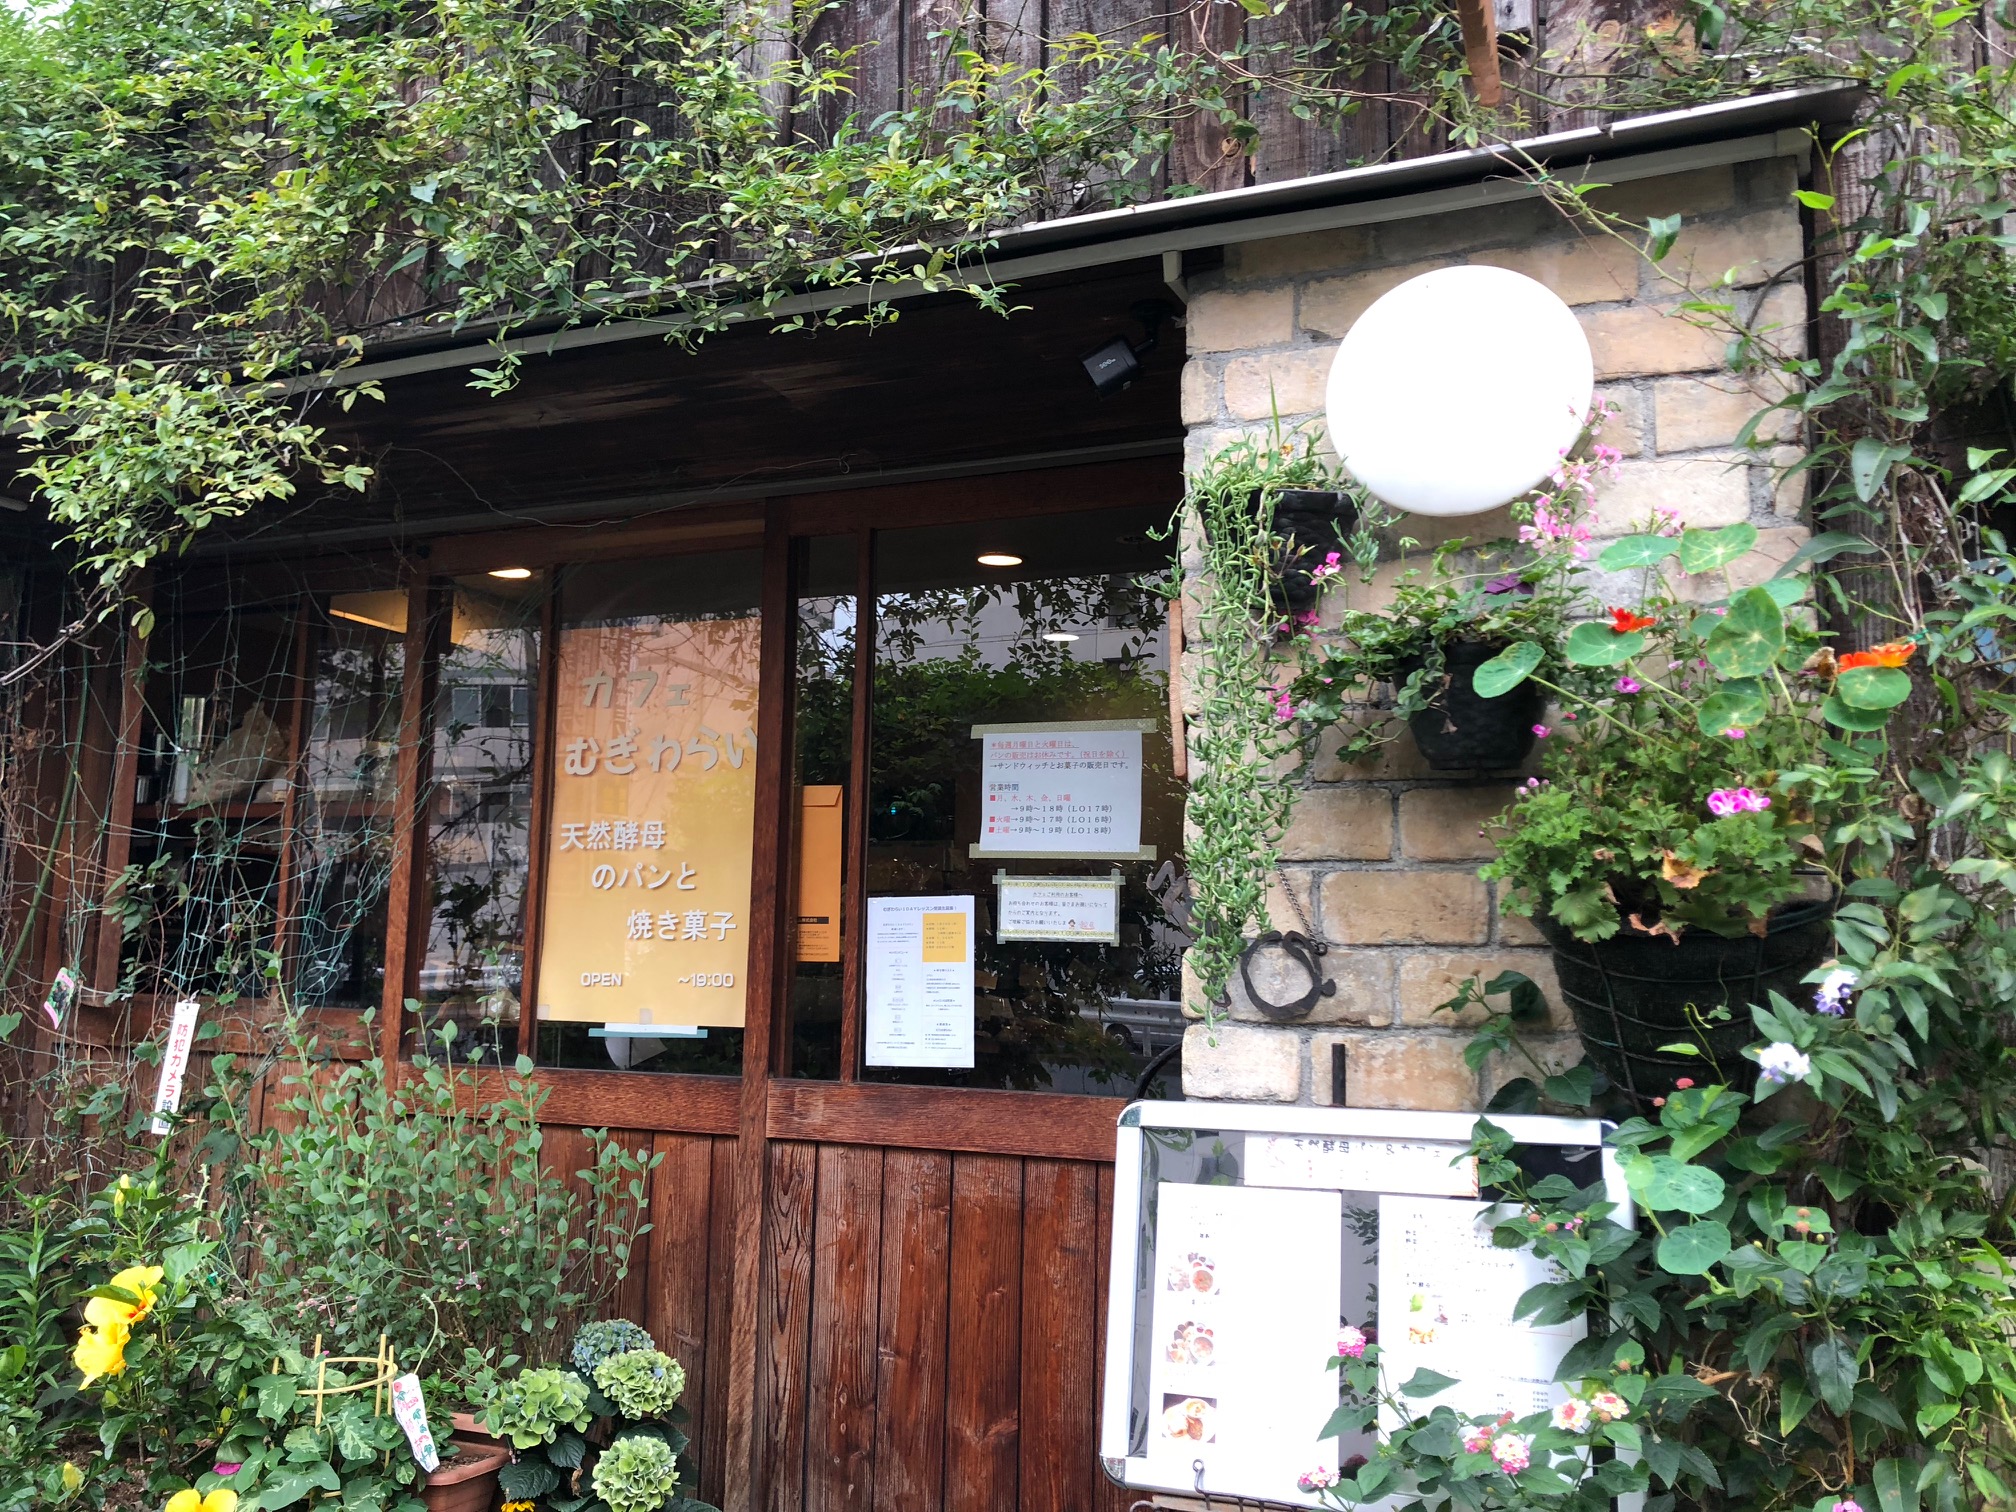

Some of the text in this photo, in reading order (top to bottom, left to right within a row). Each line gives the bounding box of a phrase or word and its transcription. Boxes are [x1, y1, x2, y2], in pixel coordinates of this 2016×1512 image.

[581, 669, 693, 708] カフェ
[564, 725, 758, 777] むぎわらい
[988, 783, 1020, 792] 営業時間
[560, 821, 667, 851] 天然酵母
[591, 862, 697, 890] のパンと
[626, 909, 738, 941] 焼き菓子
[580, 972, 623, 986] OPEN
